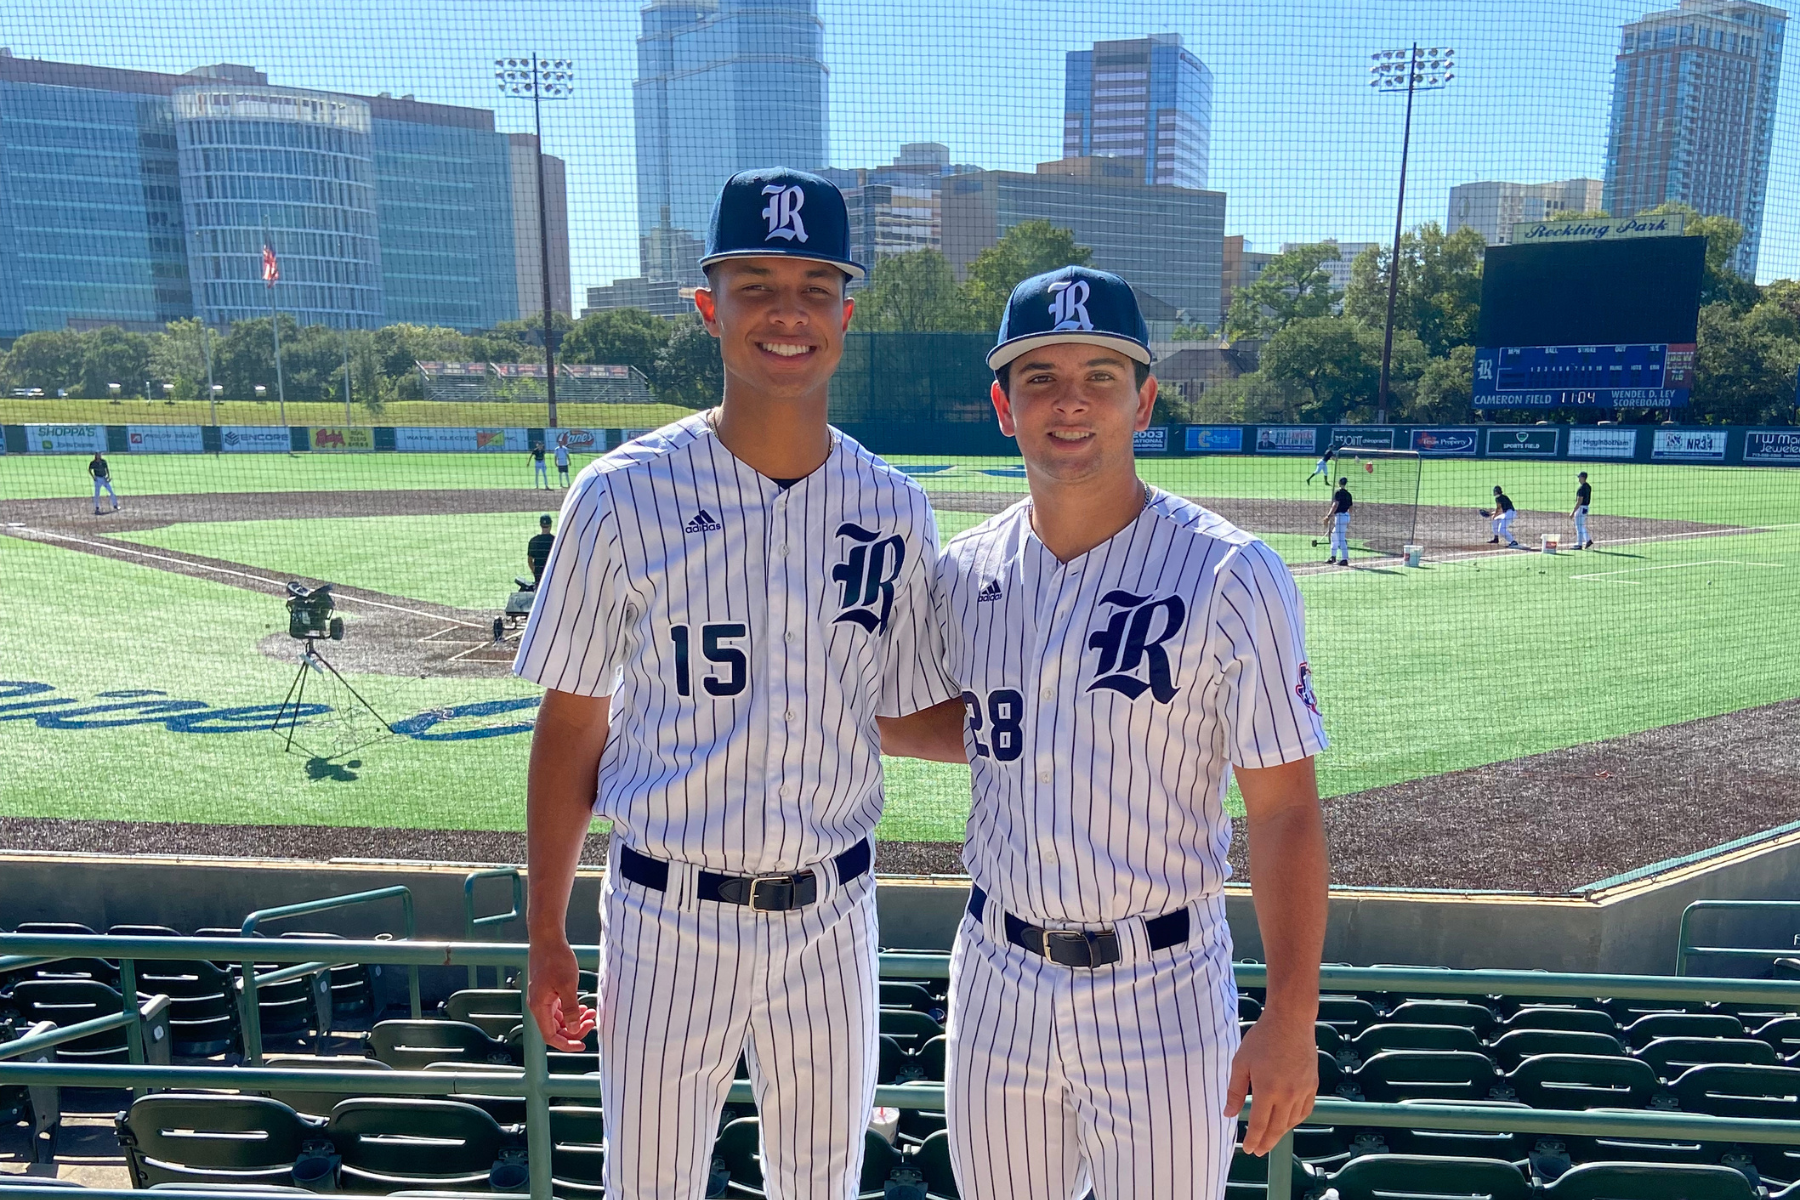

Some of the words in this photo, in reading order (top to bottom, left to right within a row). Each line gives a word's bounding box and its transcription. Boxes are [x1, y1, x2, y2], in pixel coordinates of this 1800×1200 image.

[761, 184, 809, 243] R
[1616, 218, 1668, 234] Park
[1047, 280, 1094, 331] R
[1474, 394, 1523, 405] CAMERON
[1525, 394, 1552, 404] FIELD
[1561, 391, 1596, 404] 11:04
[1611, 390, 1646, 398] WENDEL
[1648, 390, 1657, 398] D.
[1660, 390, 1676, 398] LEY
[1613, 398, 1671, 407] SCOREBOARD
[38, 426, 95, 437] SHOPPA'S
[241, 433, 289, 441] ENCORE
[1133, 430, 1164, 439] 2003
[1440, 438, 1467, 446] Property
[685, 523, 722, 534] adidas
[827, 521, 907, 638] R
[1085, 589, 1186, 705] R
[670, 622, 748, 698] 15
[961, 688, 1024, 762] 28
